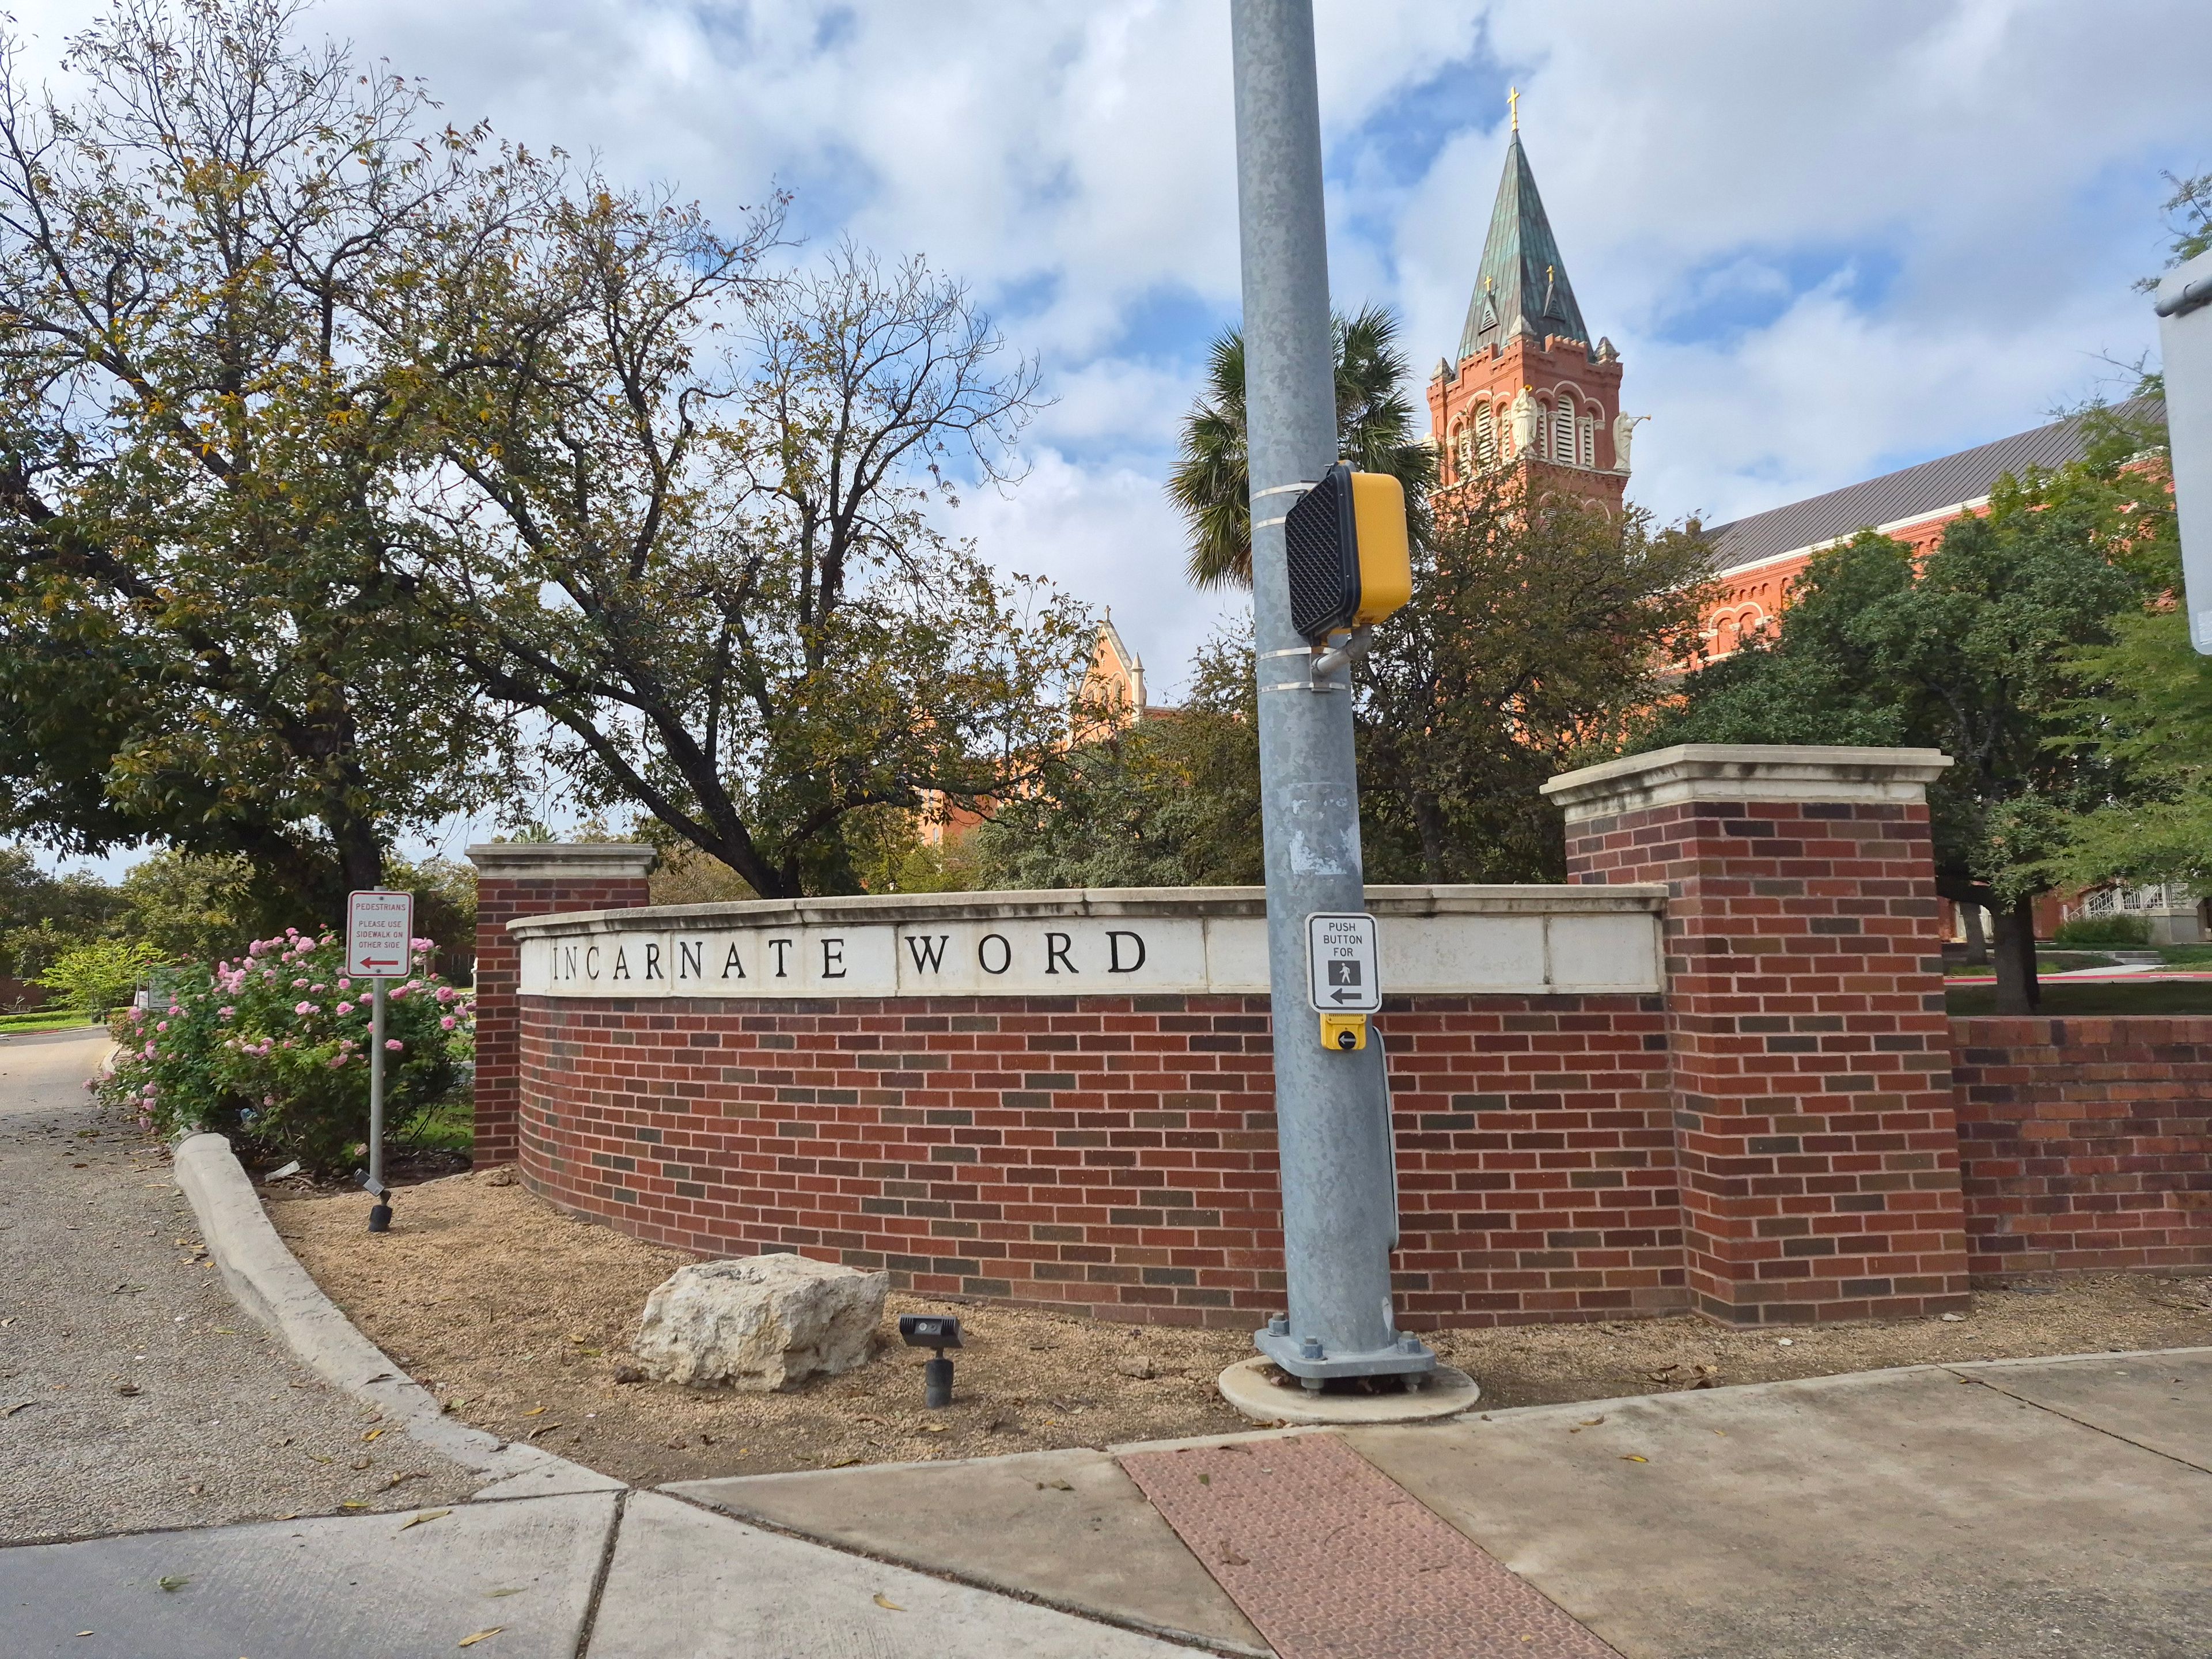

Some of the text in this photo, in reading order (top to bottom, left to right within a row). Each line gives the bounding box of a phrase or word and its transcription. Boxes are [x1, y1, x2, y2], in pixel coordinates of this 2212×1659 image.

[1328, 922, 1356, 931] PUSH
[1323, 935, 1363, 944] BUTTON
[553, 931, 1146, 980] INCARNATE WORD
[1334, 948, 1354, 957] FOR
